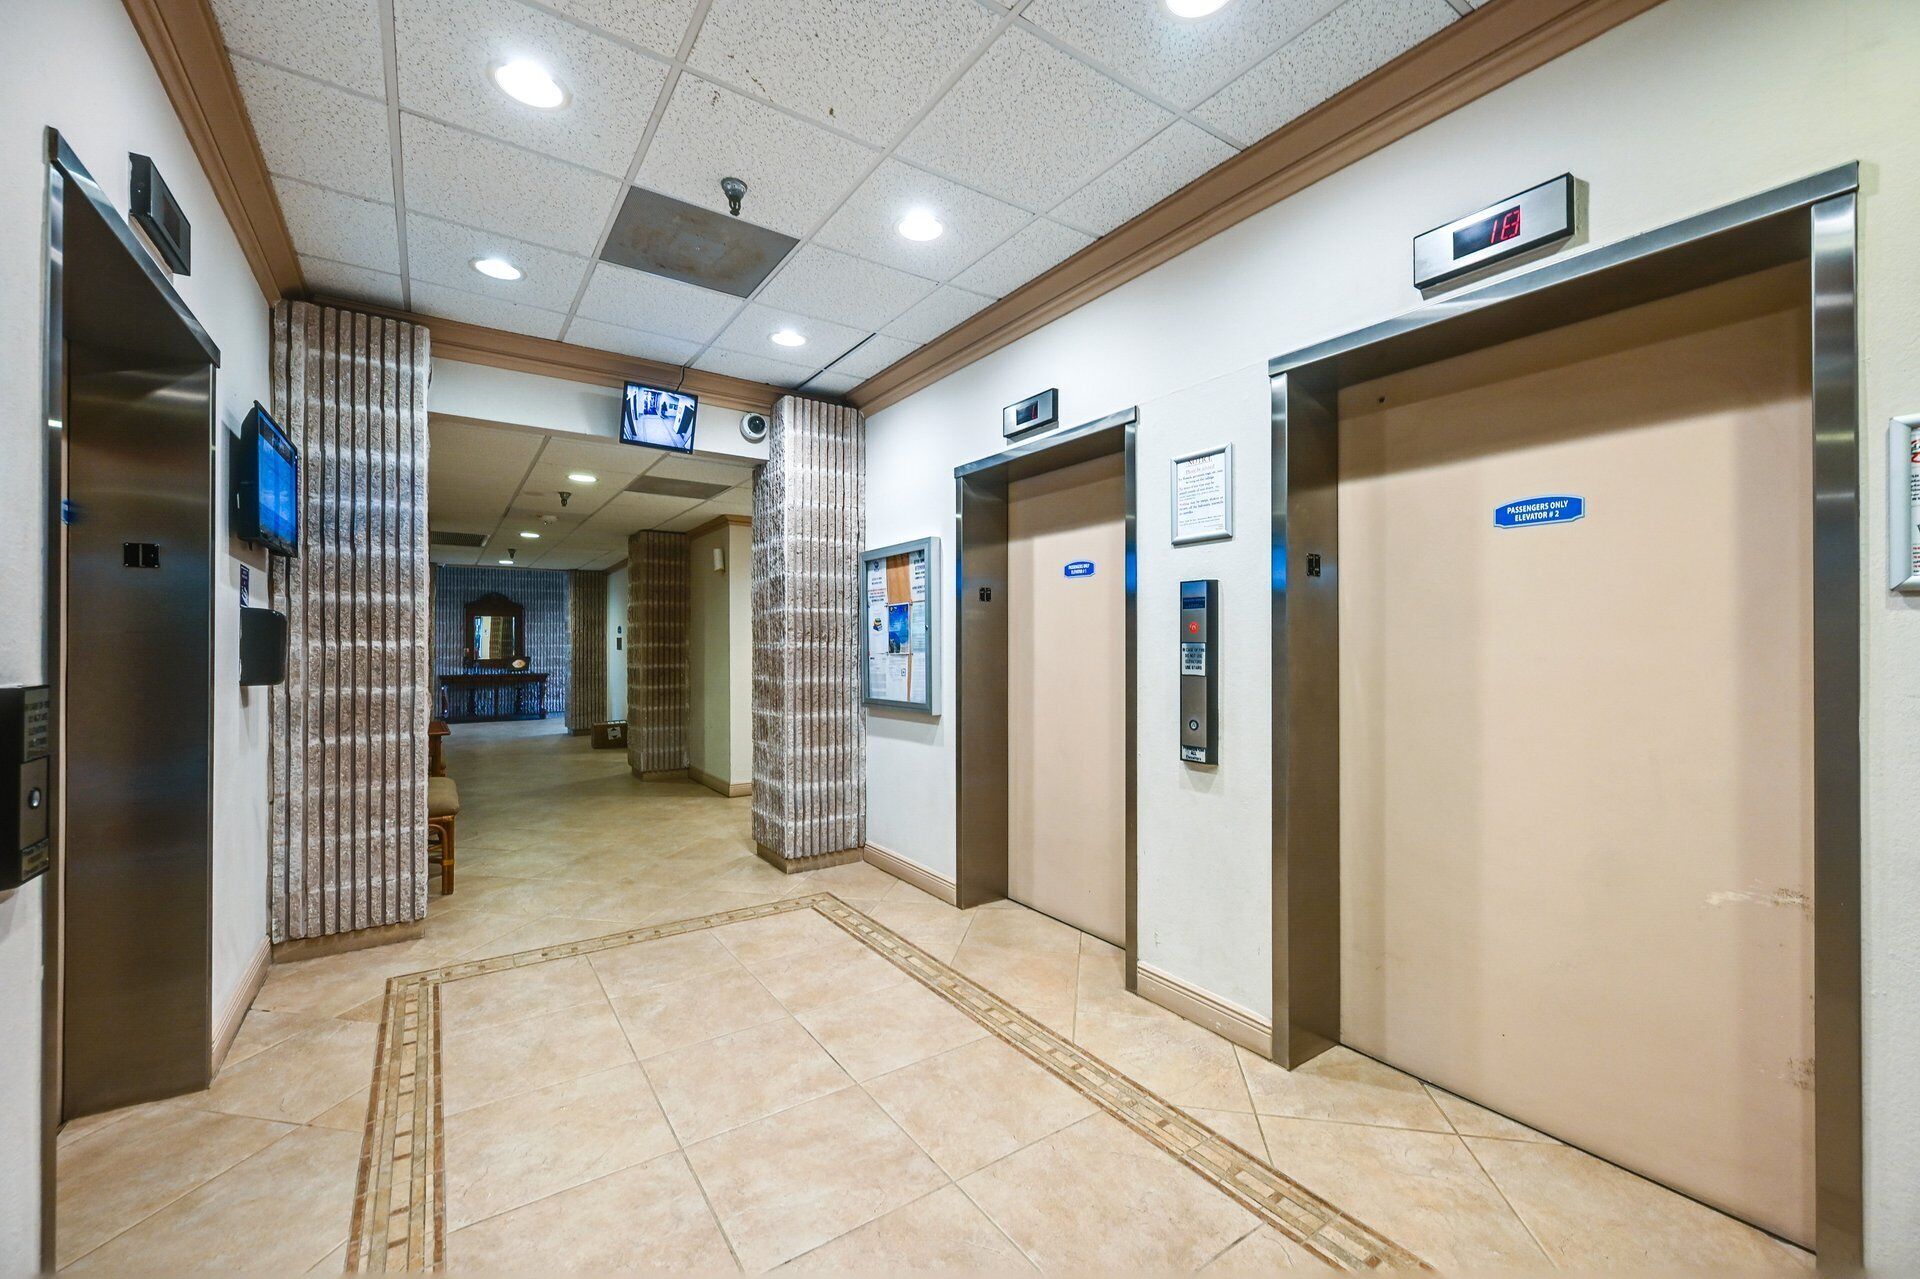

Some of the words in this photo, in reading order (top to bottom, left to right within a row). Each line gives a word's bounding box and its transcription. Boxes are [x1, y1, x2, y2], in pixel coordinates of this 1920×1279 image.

[1490, 210, 1520, 243] 18
[1507, 502, 1549, 514] PASSENGERS
[1550, 500, 1568, 509] ONLY
[1514, 511, 1548, 522] ELEVATOR
[1554, 510, 1560, 518] 2
